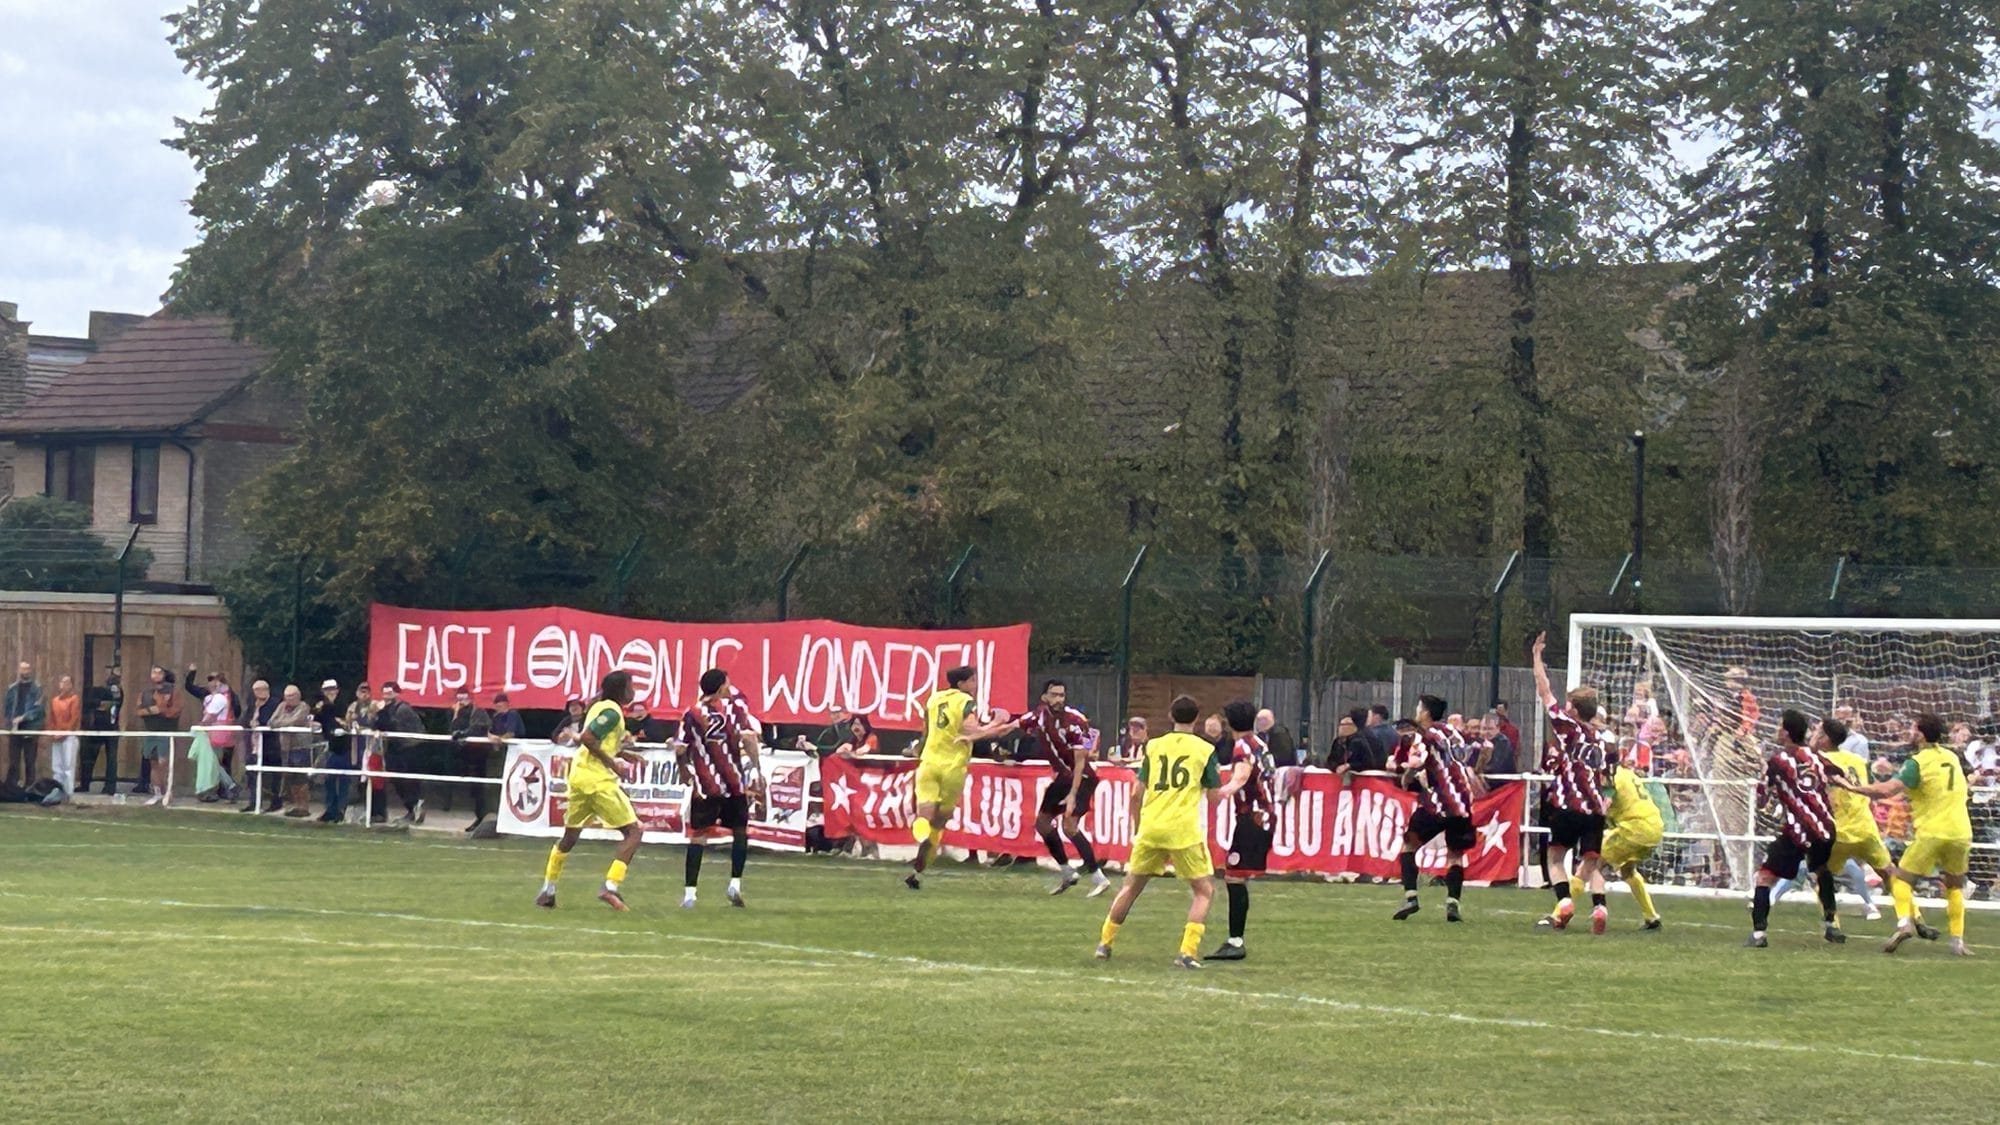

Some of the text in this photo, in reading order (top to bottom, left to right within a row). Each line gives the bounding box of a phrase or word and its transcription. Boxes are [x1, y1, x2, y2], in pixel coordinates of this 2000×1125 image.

[397, 622, 492, 696] EAST
[503, 624, 684, 709] LONDON
[1154, 754, 1190, 791] 16
[1940, 762, 1956, 791] 7
[945, 773, 1024, 840] LUB
[1330, 788, 1405, 863] AND
